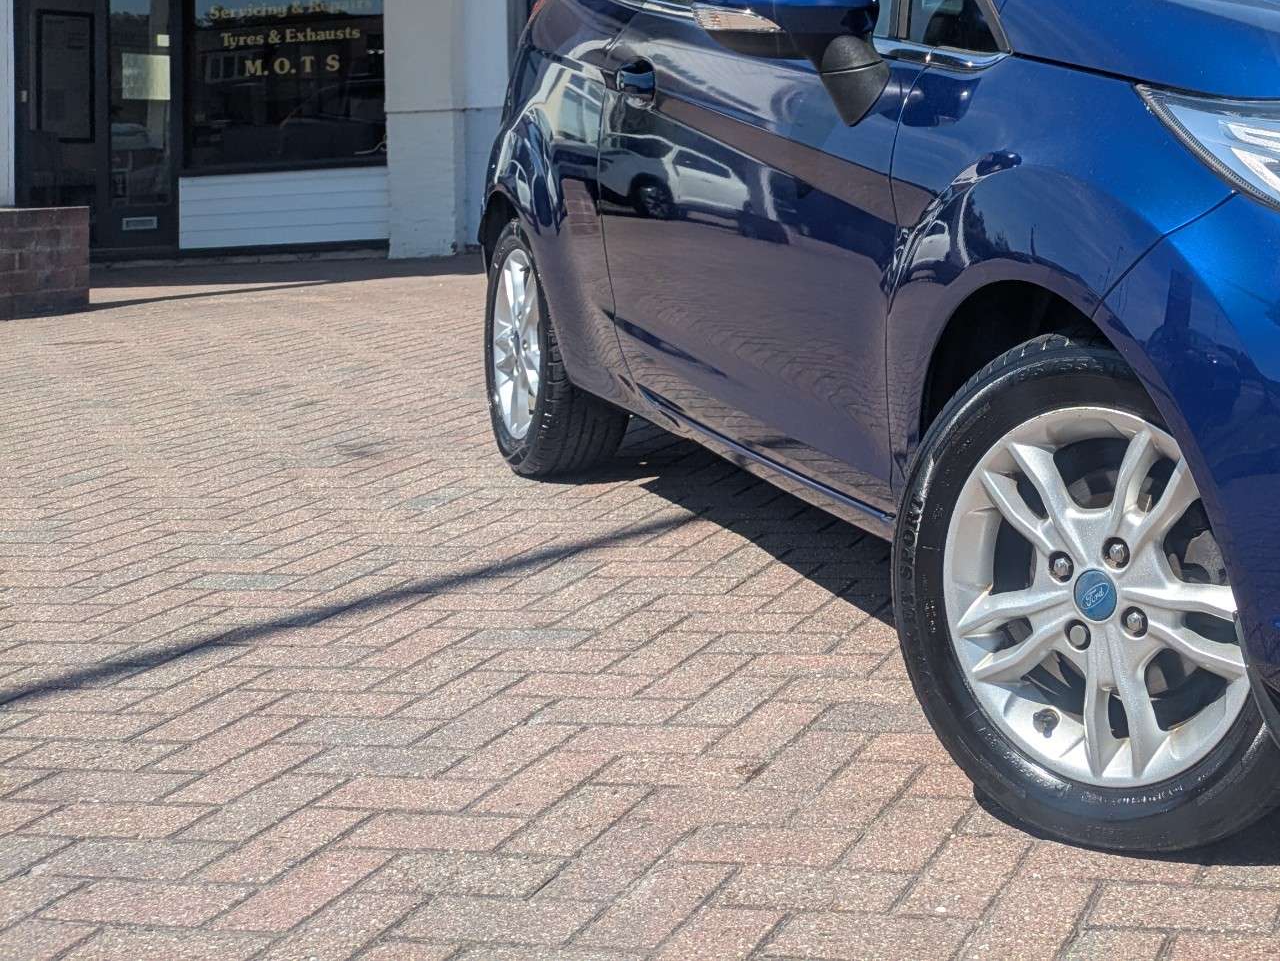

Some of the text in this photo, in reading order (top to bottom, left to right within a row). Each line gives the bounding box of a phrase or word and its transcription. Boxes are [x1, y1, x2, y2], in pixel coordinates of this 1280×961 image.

[209, 2, 287, 20] Servicing
[291, 0, 304, 15] &
[220, 27, 361, 49] Tyres & Exhausts
[1085, 586, 1105, 607] Ford
